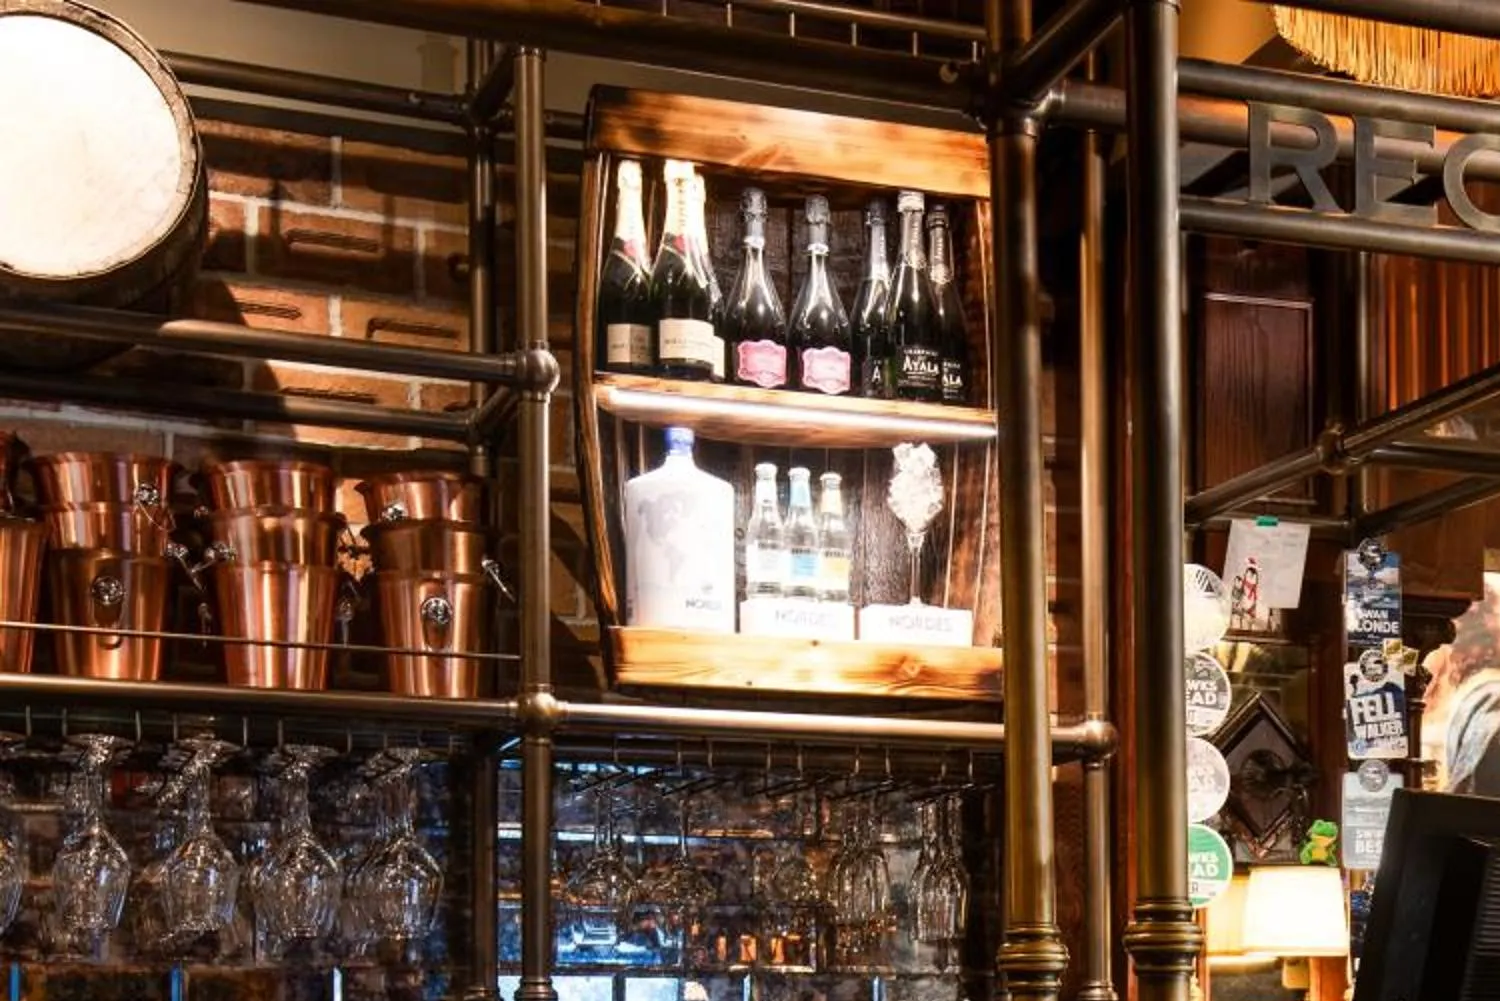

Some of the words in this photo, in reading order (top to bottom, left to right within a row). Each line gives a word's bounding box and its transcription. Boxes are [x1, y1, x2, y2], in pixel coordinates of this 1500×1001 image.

[903, 355, 940, 375] AYALA
[942, 374, 963, 388] ALA
[1352, 692, 1402, 725] FELL
